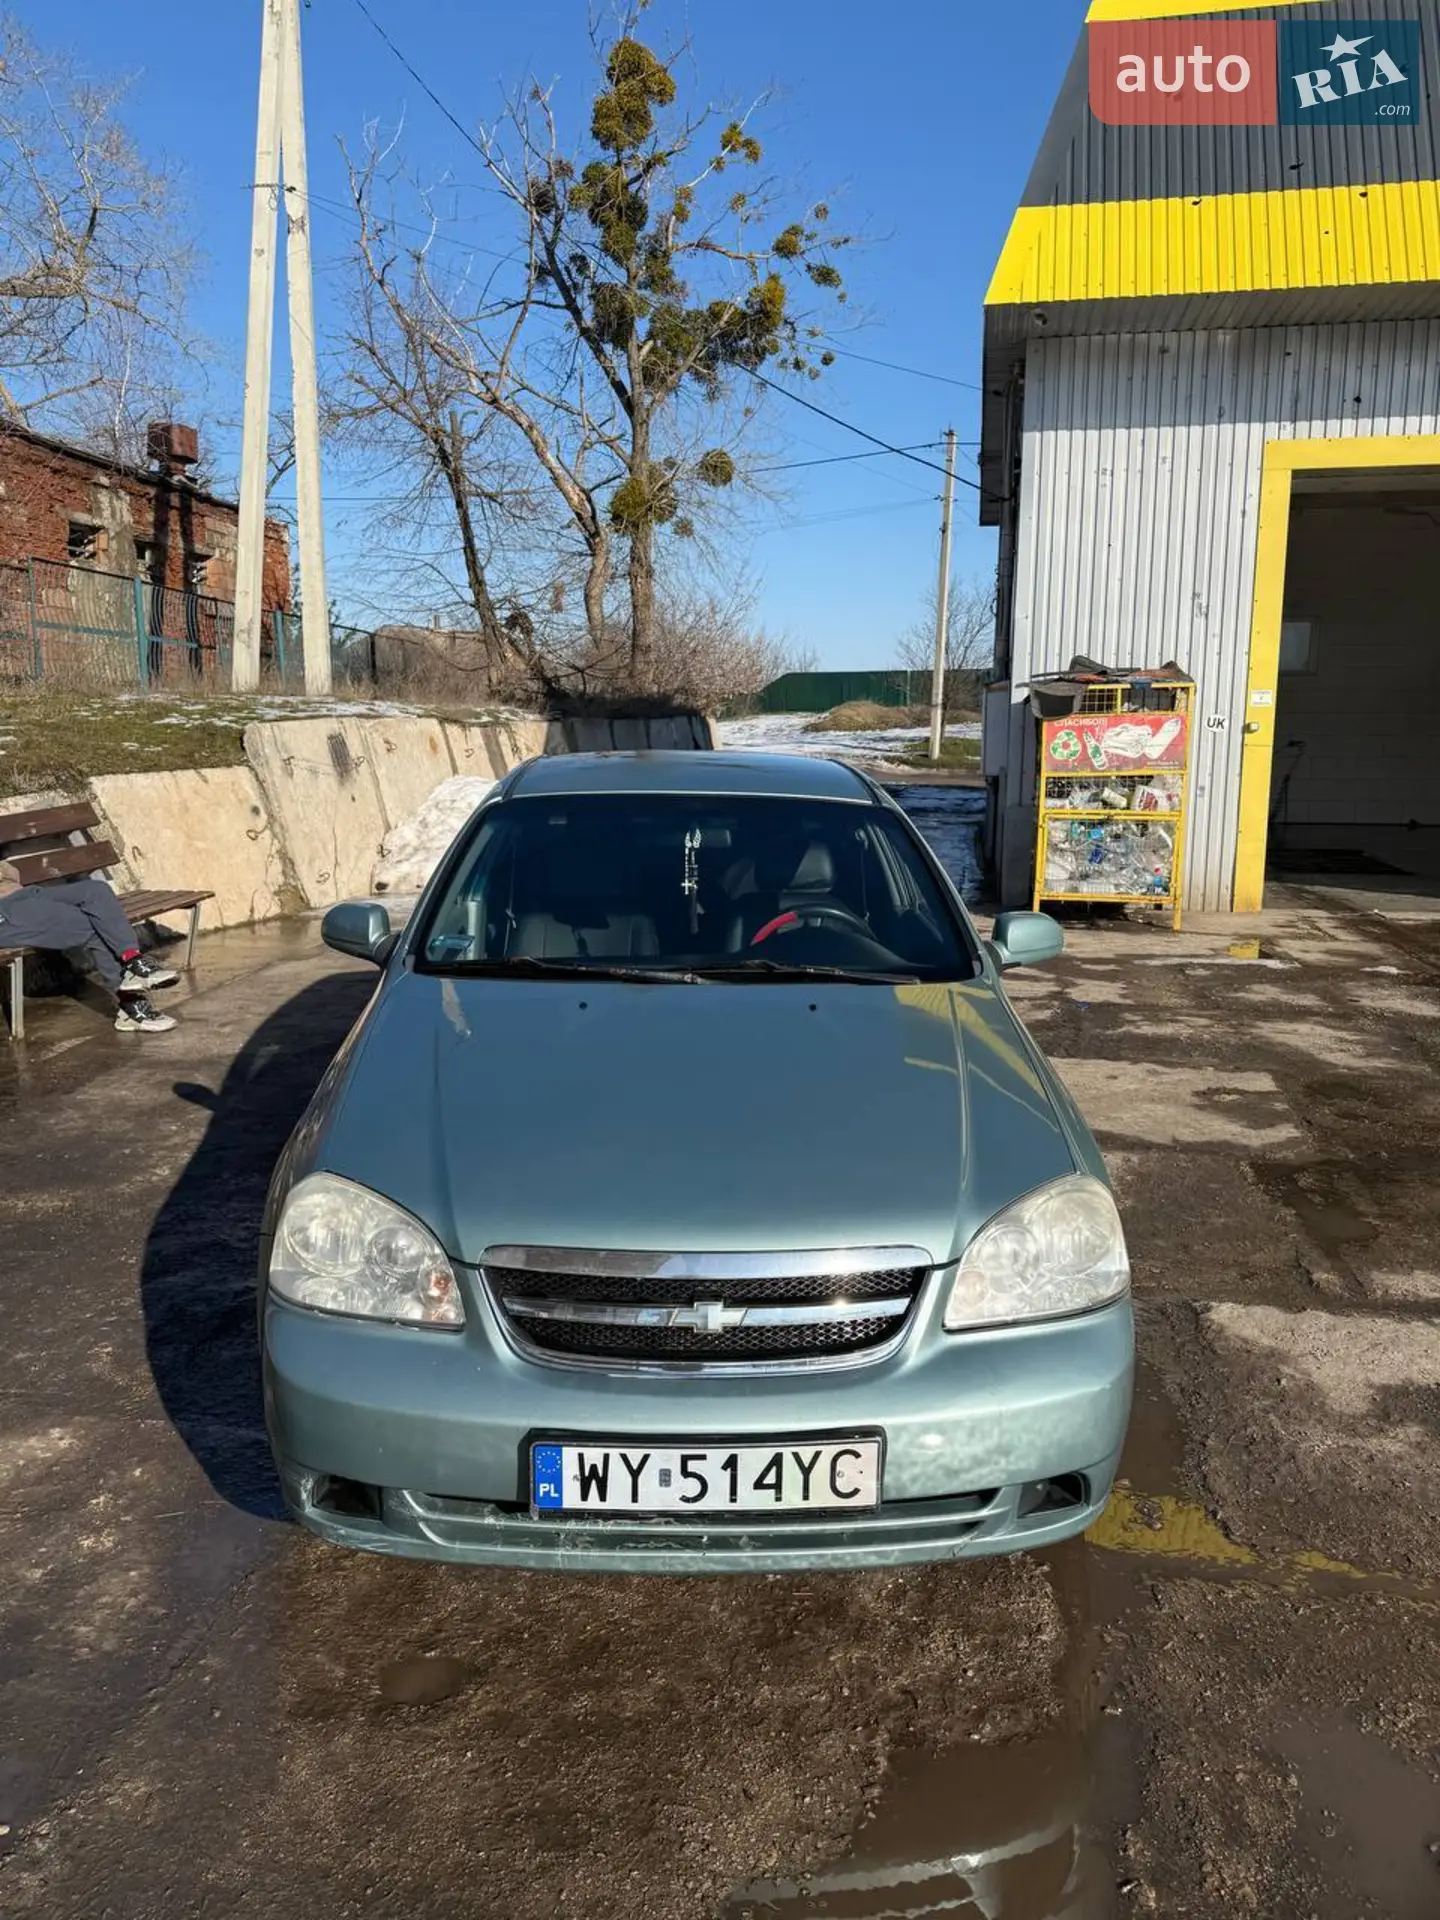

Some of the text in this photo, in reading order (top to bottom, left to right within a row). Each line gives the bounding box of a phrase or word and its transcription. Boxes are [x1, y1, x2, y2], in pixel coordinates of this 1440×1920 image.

[1207, 717, 1225, 729] UK
[577, 1449, 862, 1503] WY 514YC
[539, 1483, 559, 1498] PL
